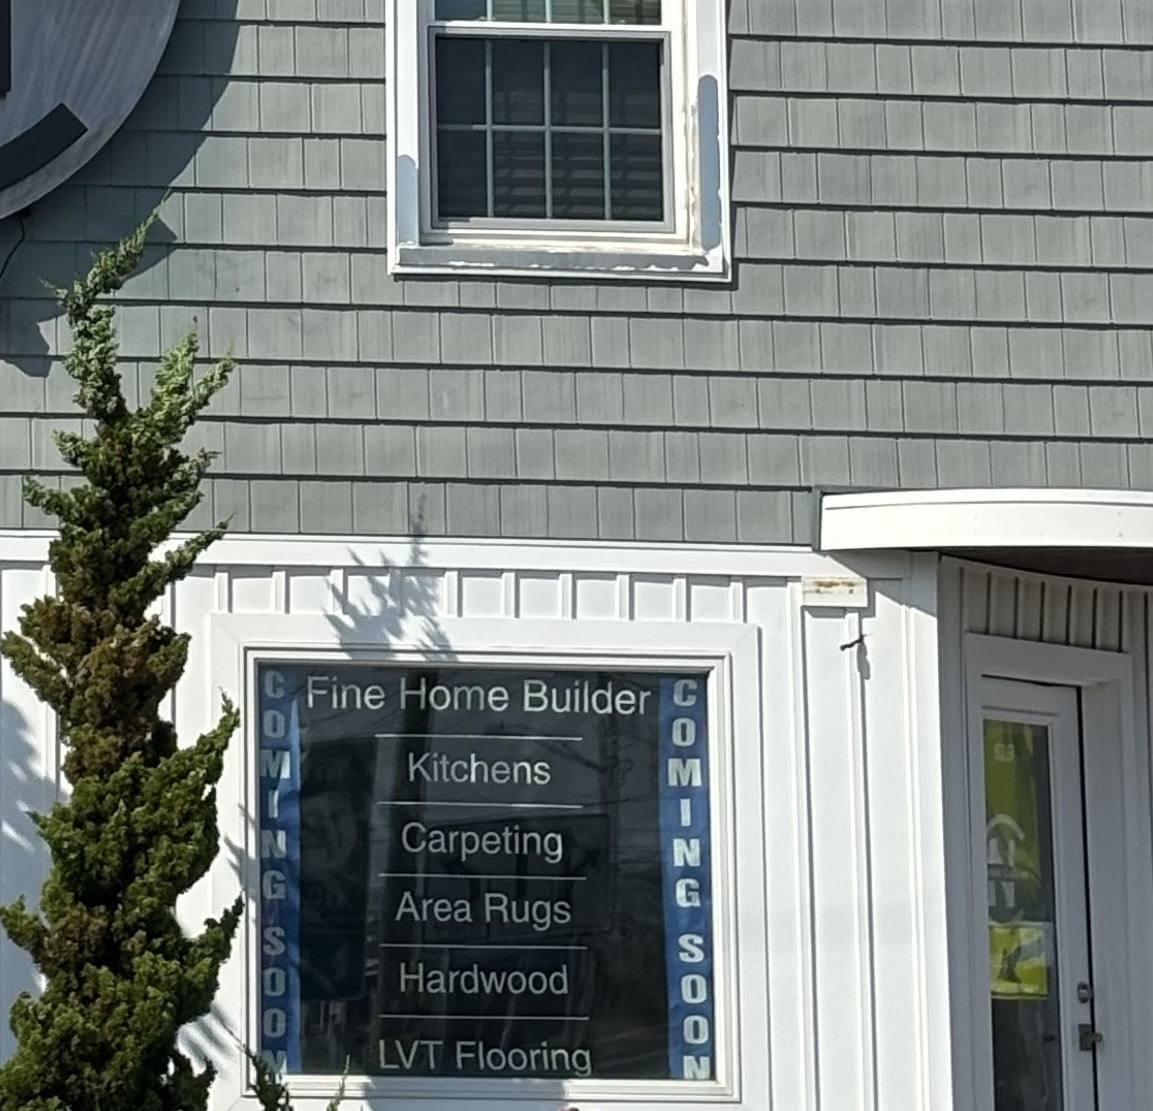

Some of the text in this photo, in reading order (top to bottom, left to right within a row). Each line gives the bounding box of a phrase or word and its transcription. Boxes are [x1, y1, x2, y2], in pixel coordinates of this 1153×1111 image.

[307, 675, 652, 715] Fine Home Builder
[260, 670, 290, 900] COMING
[408, 752, 551, 784] Kitchens
[402, 822, 563, 864] Carpeting
[667, 679, 711, 1080] COMING SOON
[395, 891, 572, 932] Area Rugs
[400, 962, 569, 995] Hardwood
[379, 1039, 592, 1078] LVT Flooring
